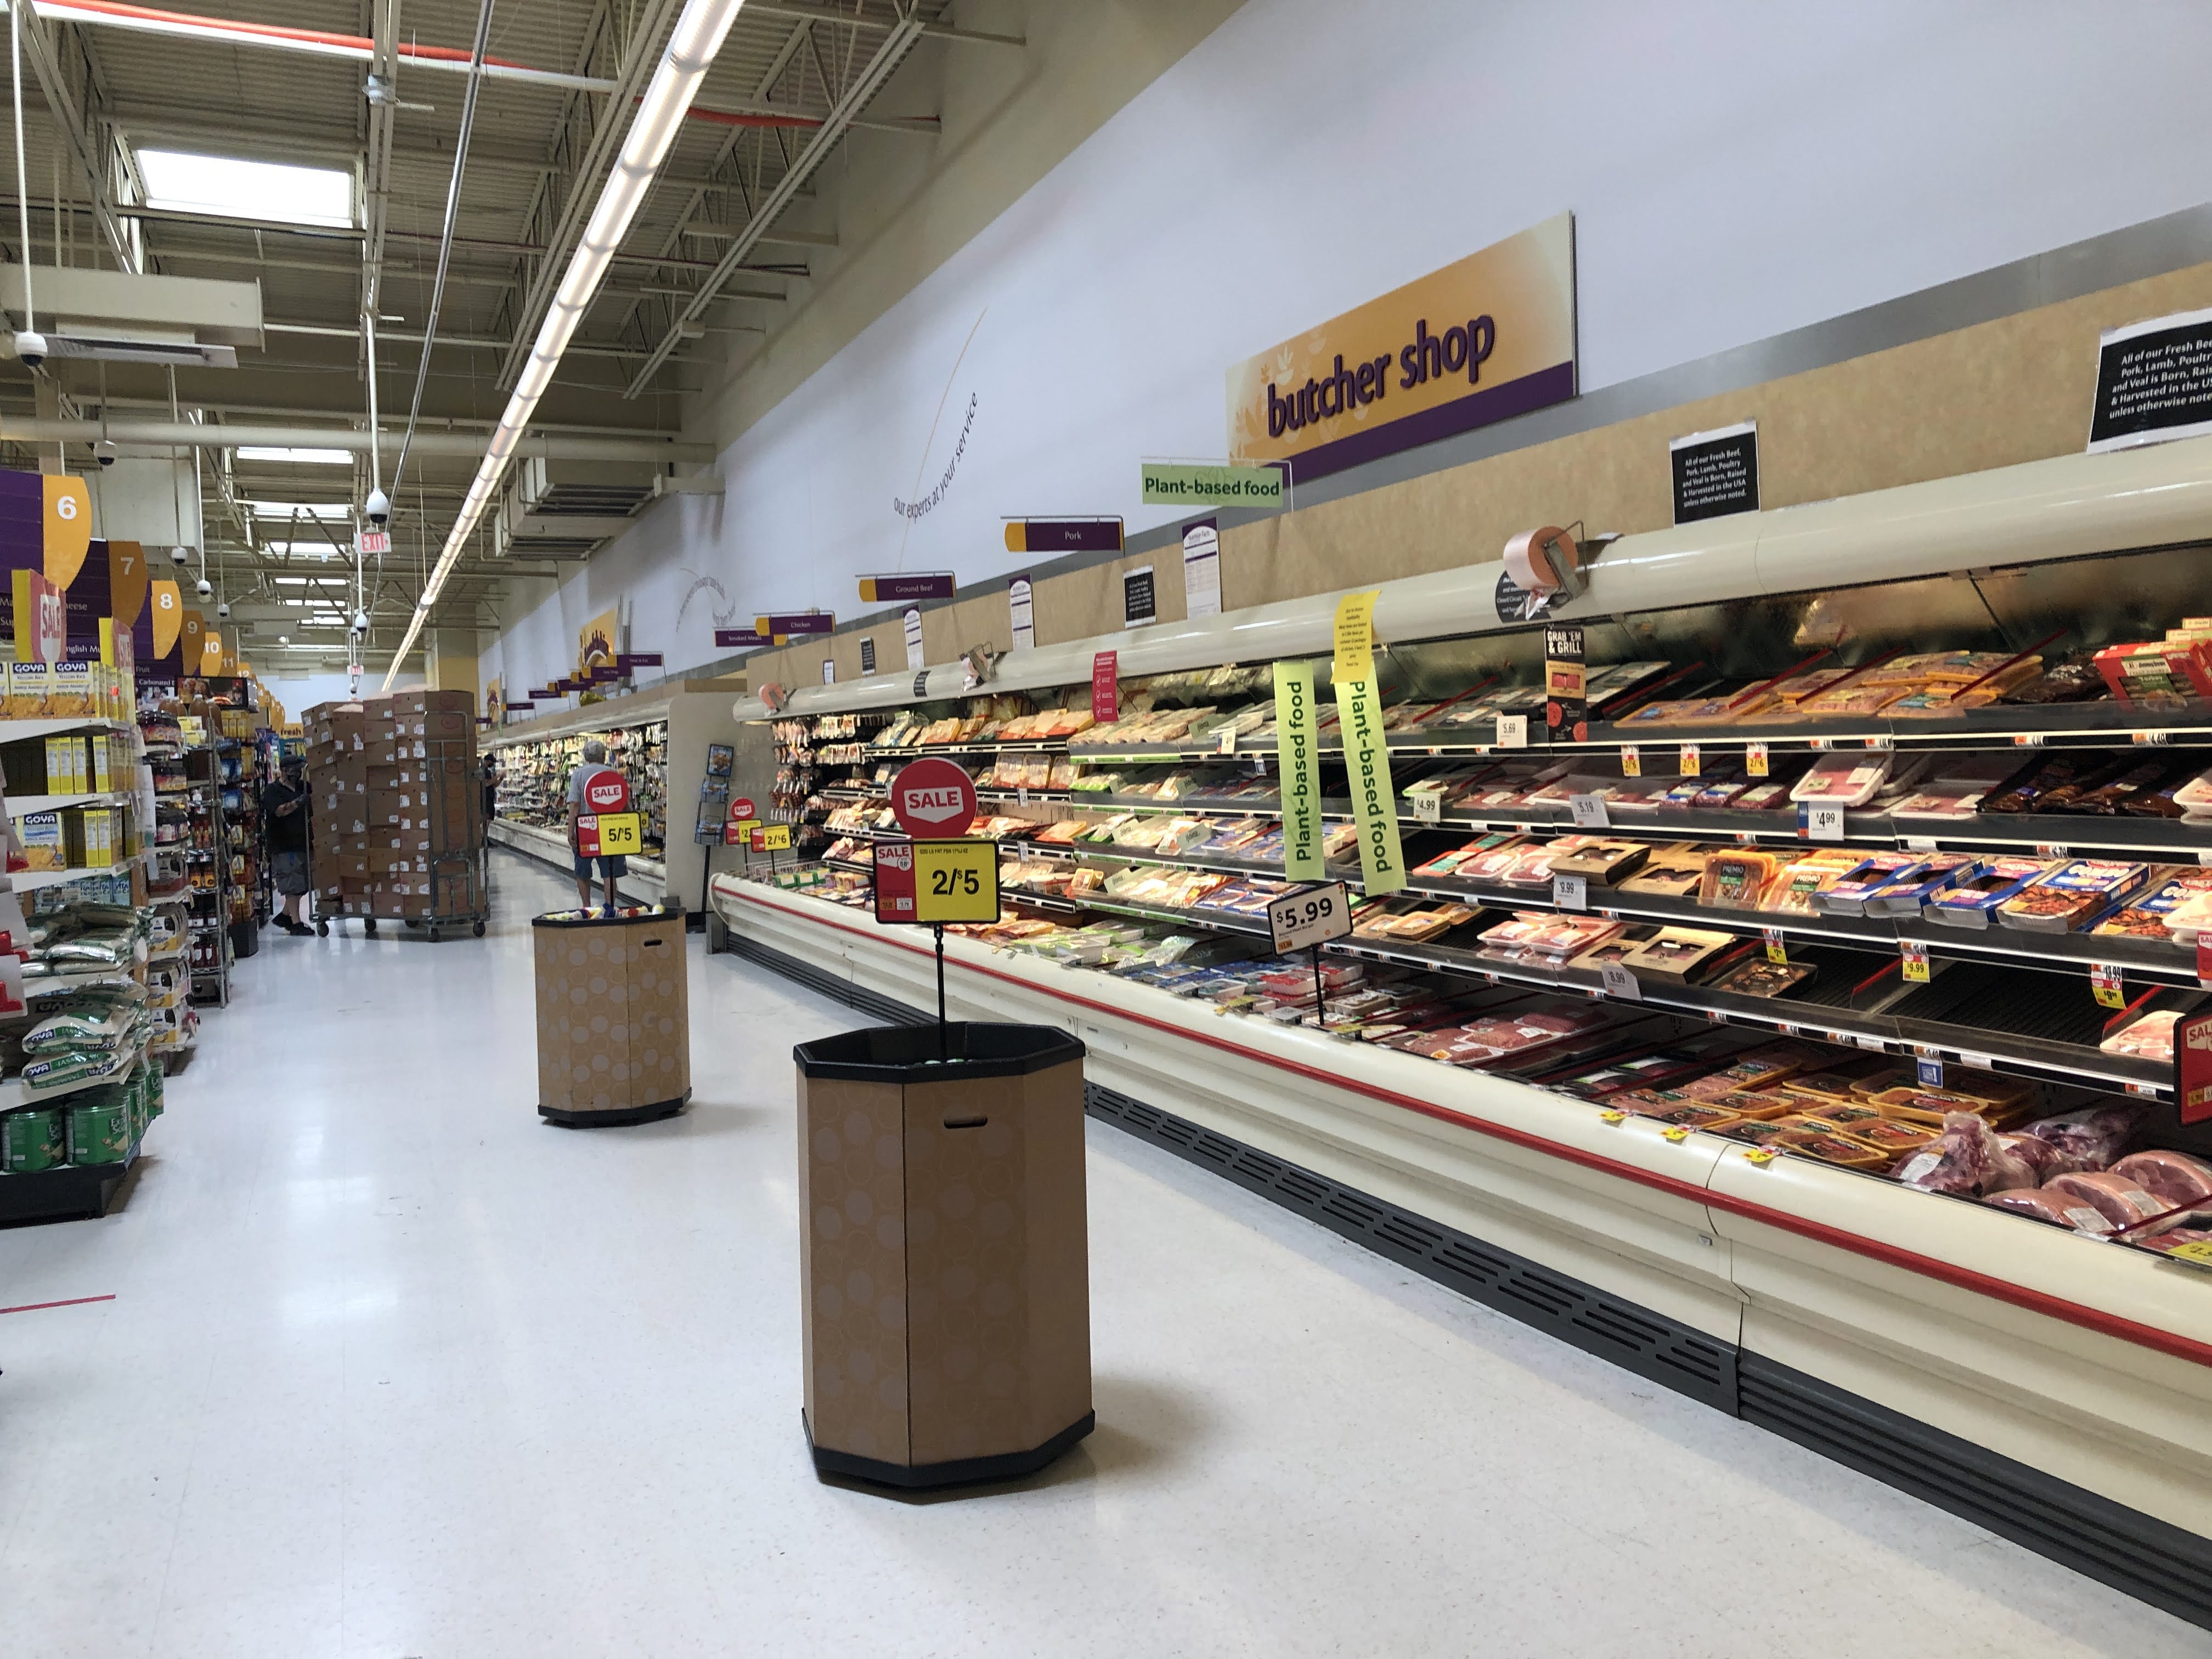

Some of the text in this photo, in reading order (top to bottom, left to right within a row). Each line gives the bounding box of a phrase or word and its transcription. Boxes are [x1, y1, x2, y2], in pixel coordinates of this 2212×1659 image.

[2121, 352, 2133, 365] All
[2134, 349, 2145, 362] of
[2146, 348, 2163, 358] our
[2165, 342, 2193, 356] Fresh
[1267, 314, 1496, 438] butcher shop
[2121, 365, 2143, 379] Pork,
[2146, 358, 2176, 373] Lamb,
[2112, 379, 2128, 394] and
[2129, 375, 2149, 388] Veal
[2151, 373, 2158, 383] is
[2161, 370, 2189, 383] Born,
[2120, 385, 2166, 404] Harvested
[2169, 383, 2179, 393] in
[2182, 380, 2199, 391] the
[2109, 407, 2135, 420] unless
[2137, 394, 2186, 412] otherwise
[894, 392, 978, 524] our experts at your service
[1709, 451, 1725, 462] Fresh
[1719, 460, 1741, 470] Poultry
[1683, 479, 1692, 488] and
[1693, 476, 1703, 486] Veal
[1728, 467, 1746, 478] Raised
[1145, 478, 1280, 496] Plant-based food
[1689, 484, 1714, 496] Harvested
[1723, 481, 1733, 489] the
[1734, 478, 1746, 488] USA
[57, 495, 77, 520] 6
[1684, 499, 1699, 508] unless
[1700, 493, 1726, 505] otherwise
[361, 533, 385, 551] EXIT
[1064, 531, 1082, 540] Pork
[120, 557, 134, 575] 7
[921, 584, 934, 592] Beef
[160, 593, 173, 610] 8
[42, 604, 61, 639] SALE
[188, 620, 198, 634] 9
[1547, 631, 1567, 642] GRAB
[205, 641, 219, 654] 10
[1548, 641, 1582, 653] & GRILL
[14, 663, 45, 673] GOYA
[57, 663, 86, 672] GOYA
[222, 658, 234, 668] 11
[1287, 681, 1312, 862] Plant-based food
[1350, 681, 1384, 817] Plant-based
[1370, 821, 1392, 873] food
[594, 787, 620, 798] SALE
[909, 791, 960, 809] SALE
[25, 815, 55, 825] GOYA
[878, 847, 910, 859] SALE
[1723, 865, 1744, 874] PREMIO
[1276, 897, 1333, 928] $5.99
[2189, 1025, 2212, 1042] SAL
[27, 1064, 50, 1076] OYA
